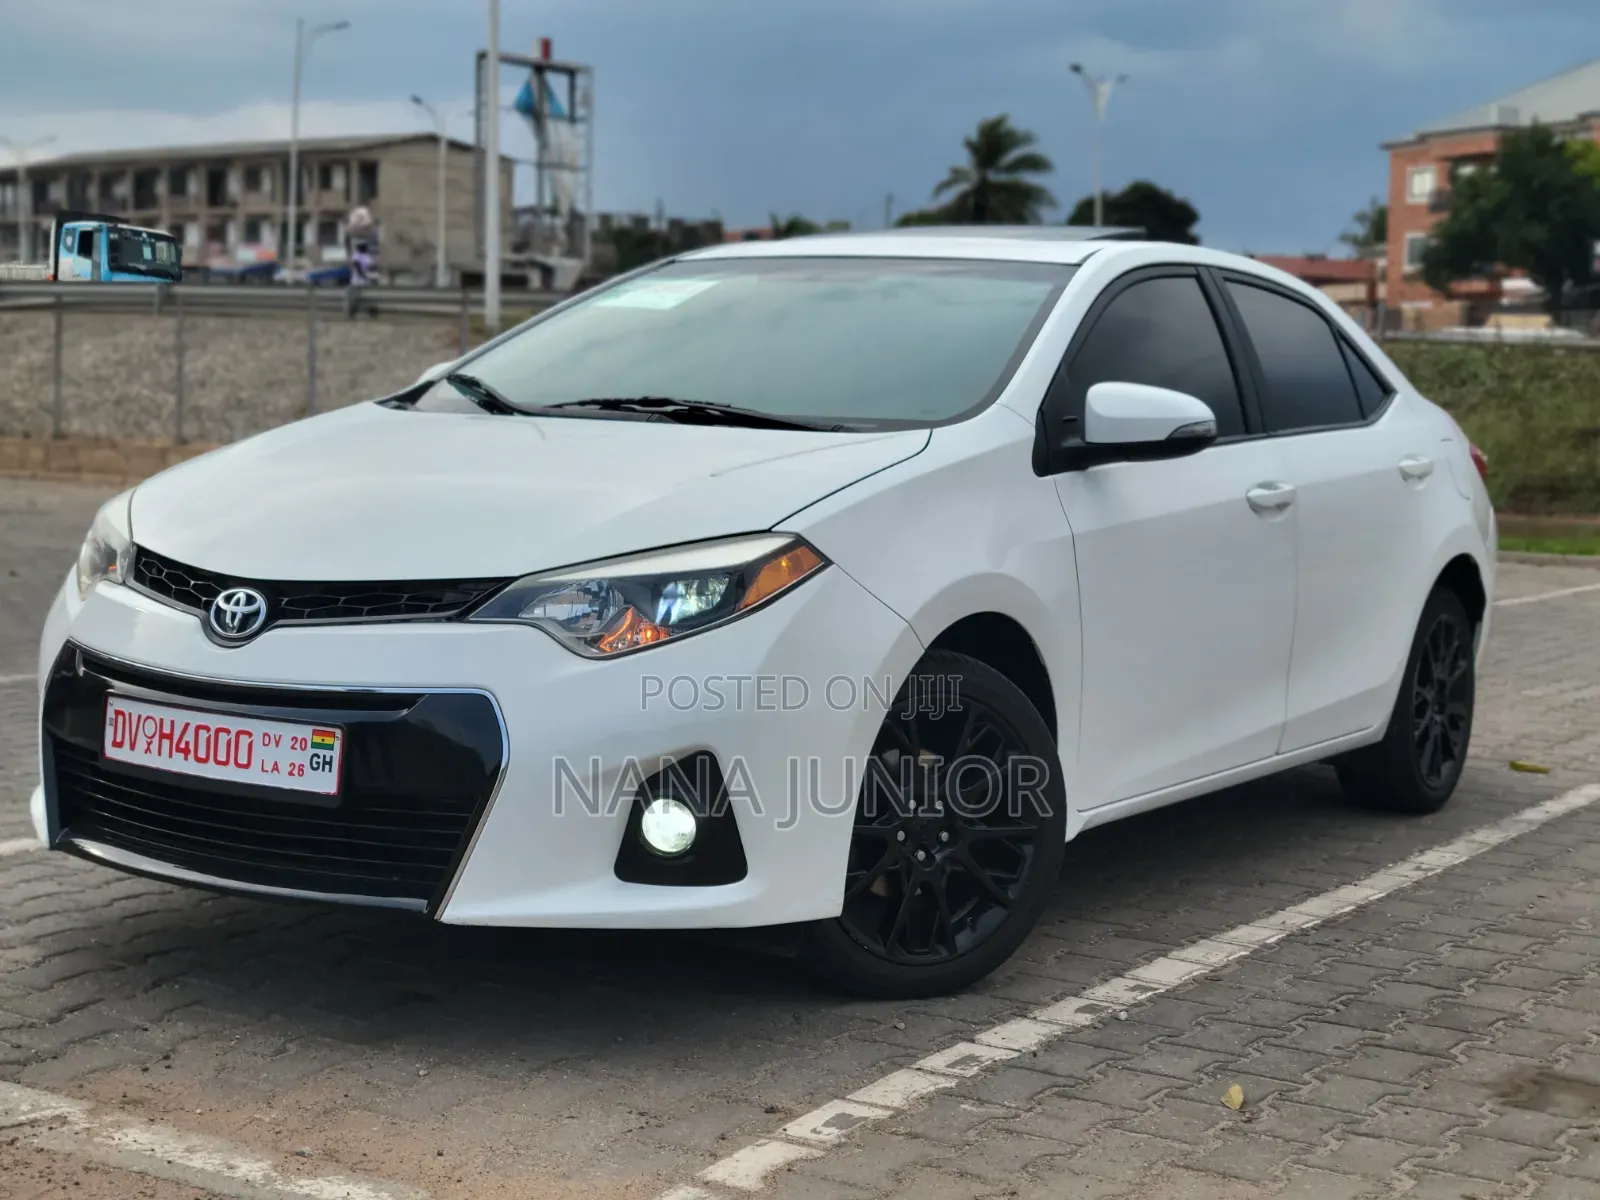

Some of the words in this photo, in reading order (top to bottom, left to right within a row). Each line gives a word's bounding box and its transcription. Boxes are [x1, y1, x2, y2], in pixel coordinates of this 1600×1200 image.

[262, 732, 282, 748] DV
[290, 735, 308, 751] 20
[260, 759, 281, 774] LA
[287, 762, 305, 777] 26
[309, 752, 333, 773] GH
